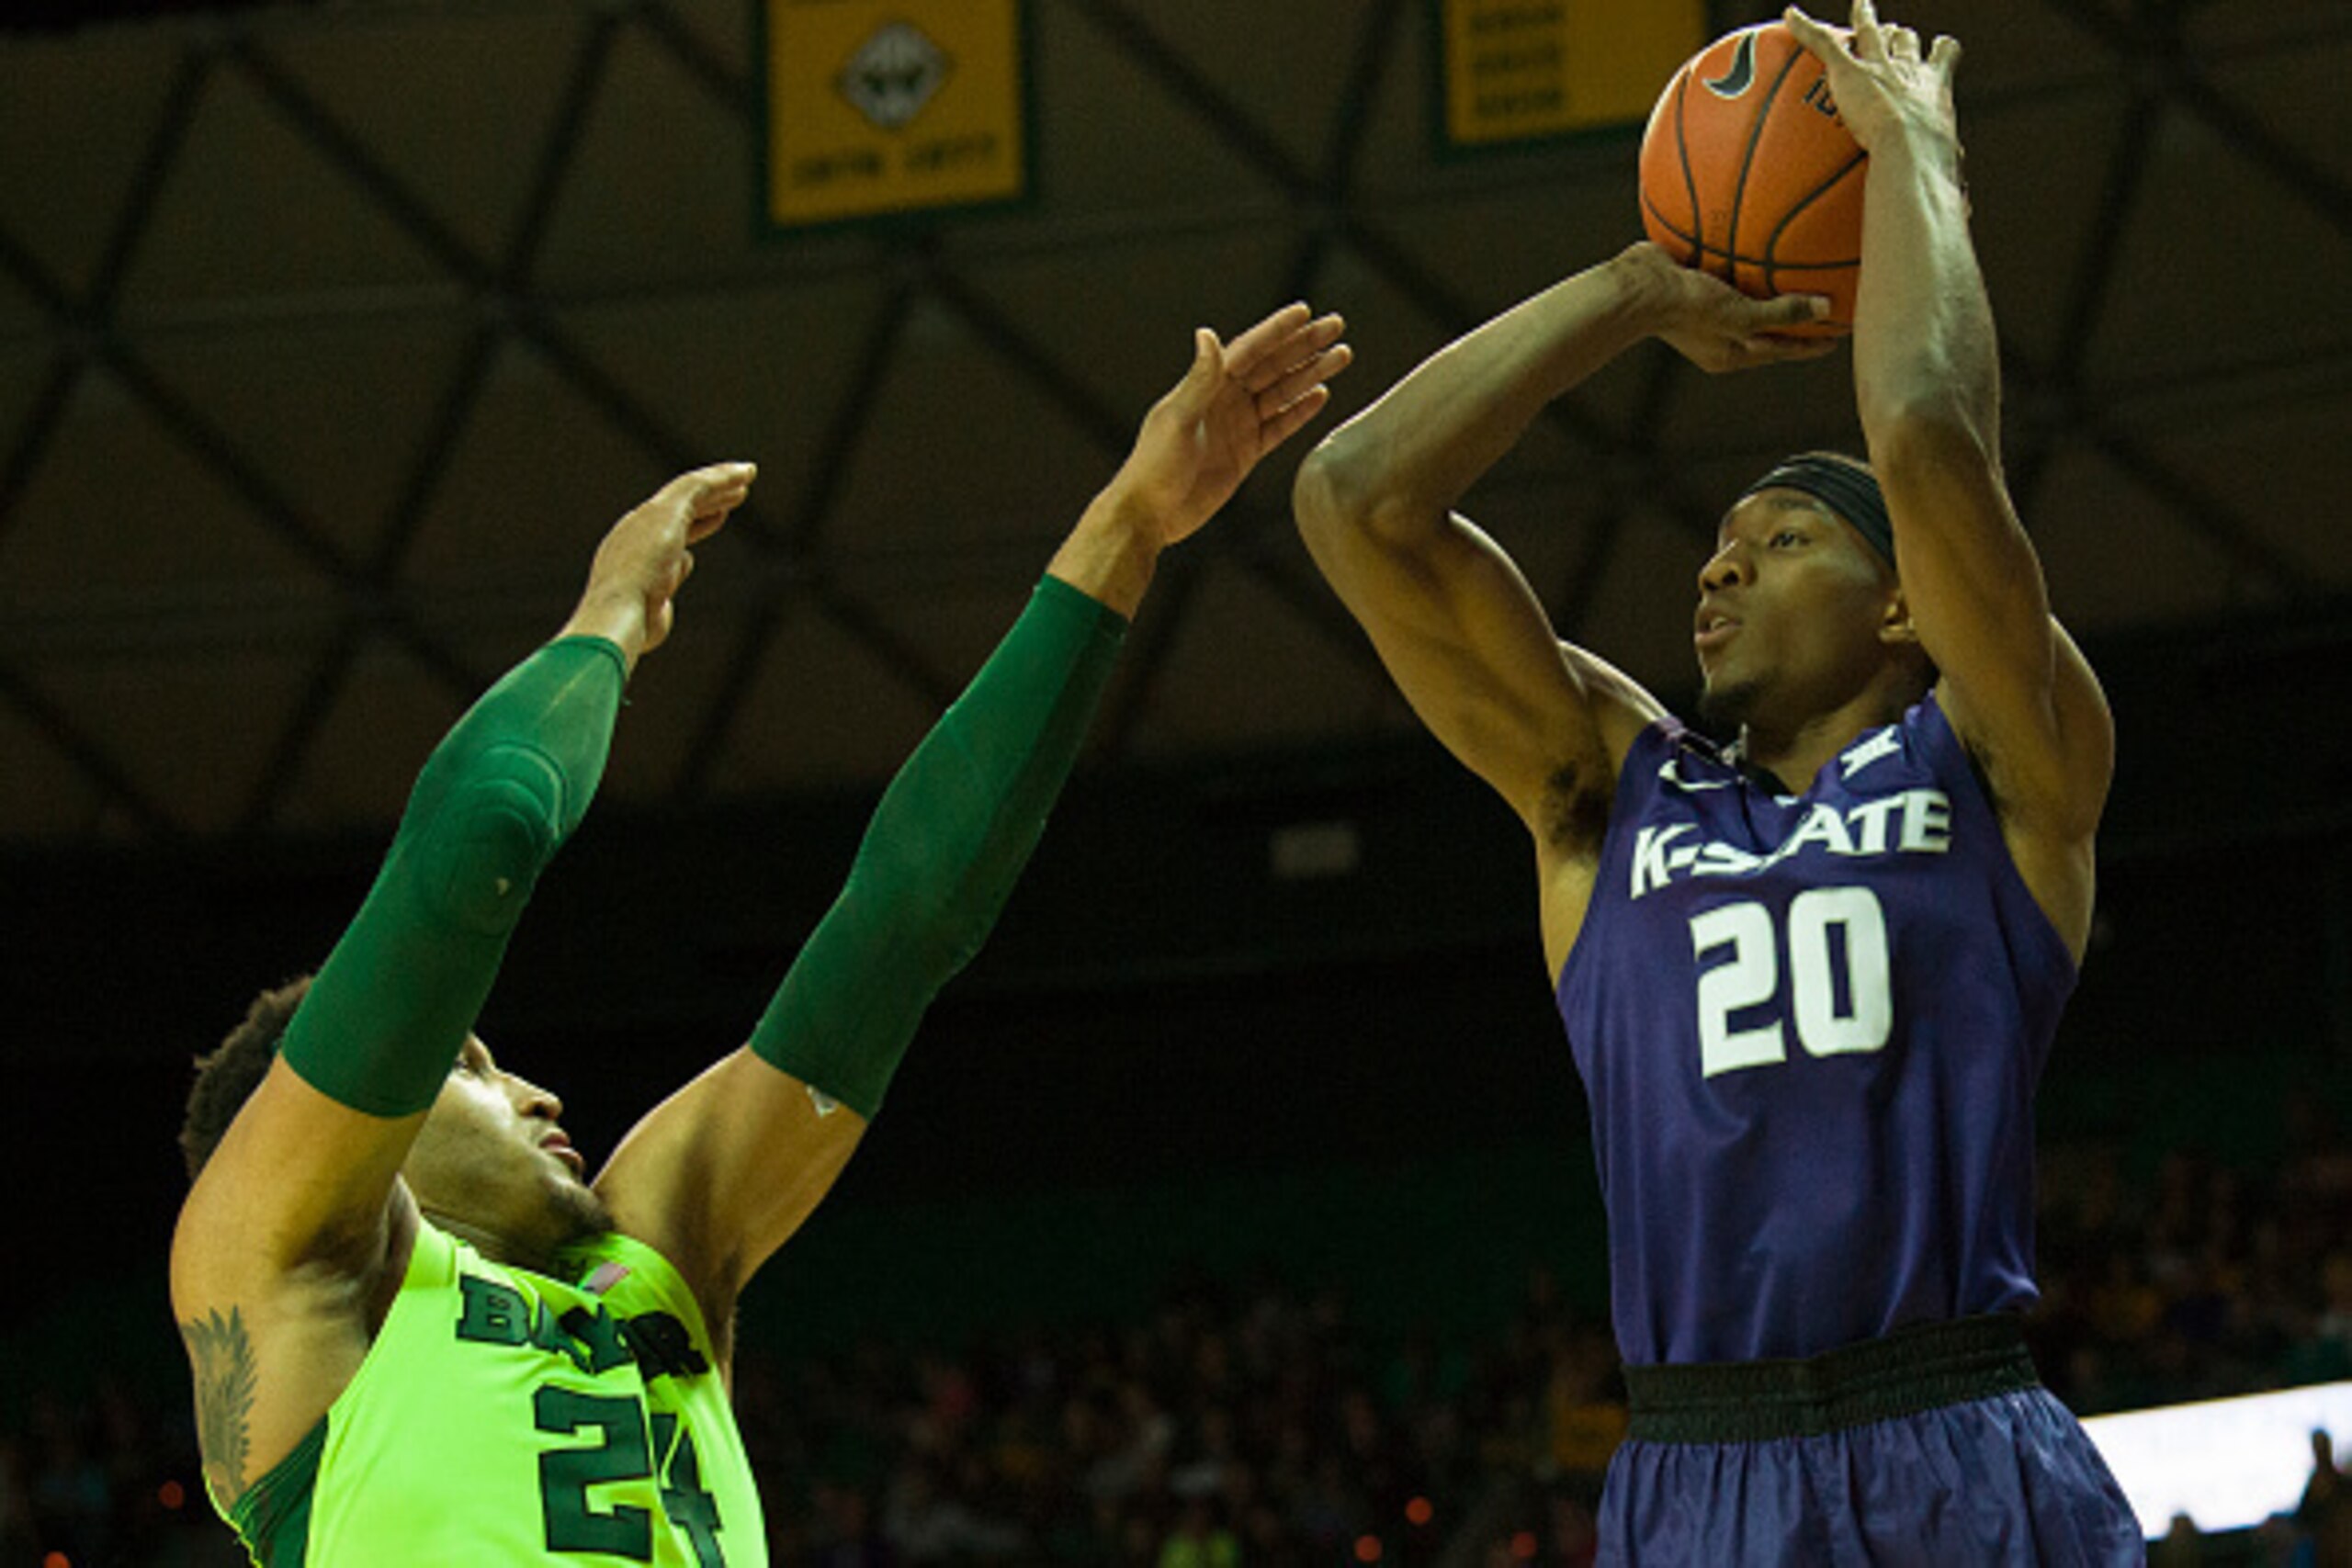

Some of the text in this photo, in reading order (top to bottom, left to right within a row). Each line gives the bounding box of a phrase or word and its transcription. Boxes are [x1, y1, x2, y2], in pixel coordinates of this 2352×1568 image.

[1631, 789, 1951, 899] K-SATE
[1690, 886, 1894, 1078] 20
[531, 1383, 726, 1568] 24
